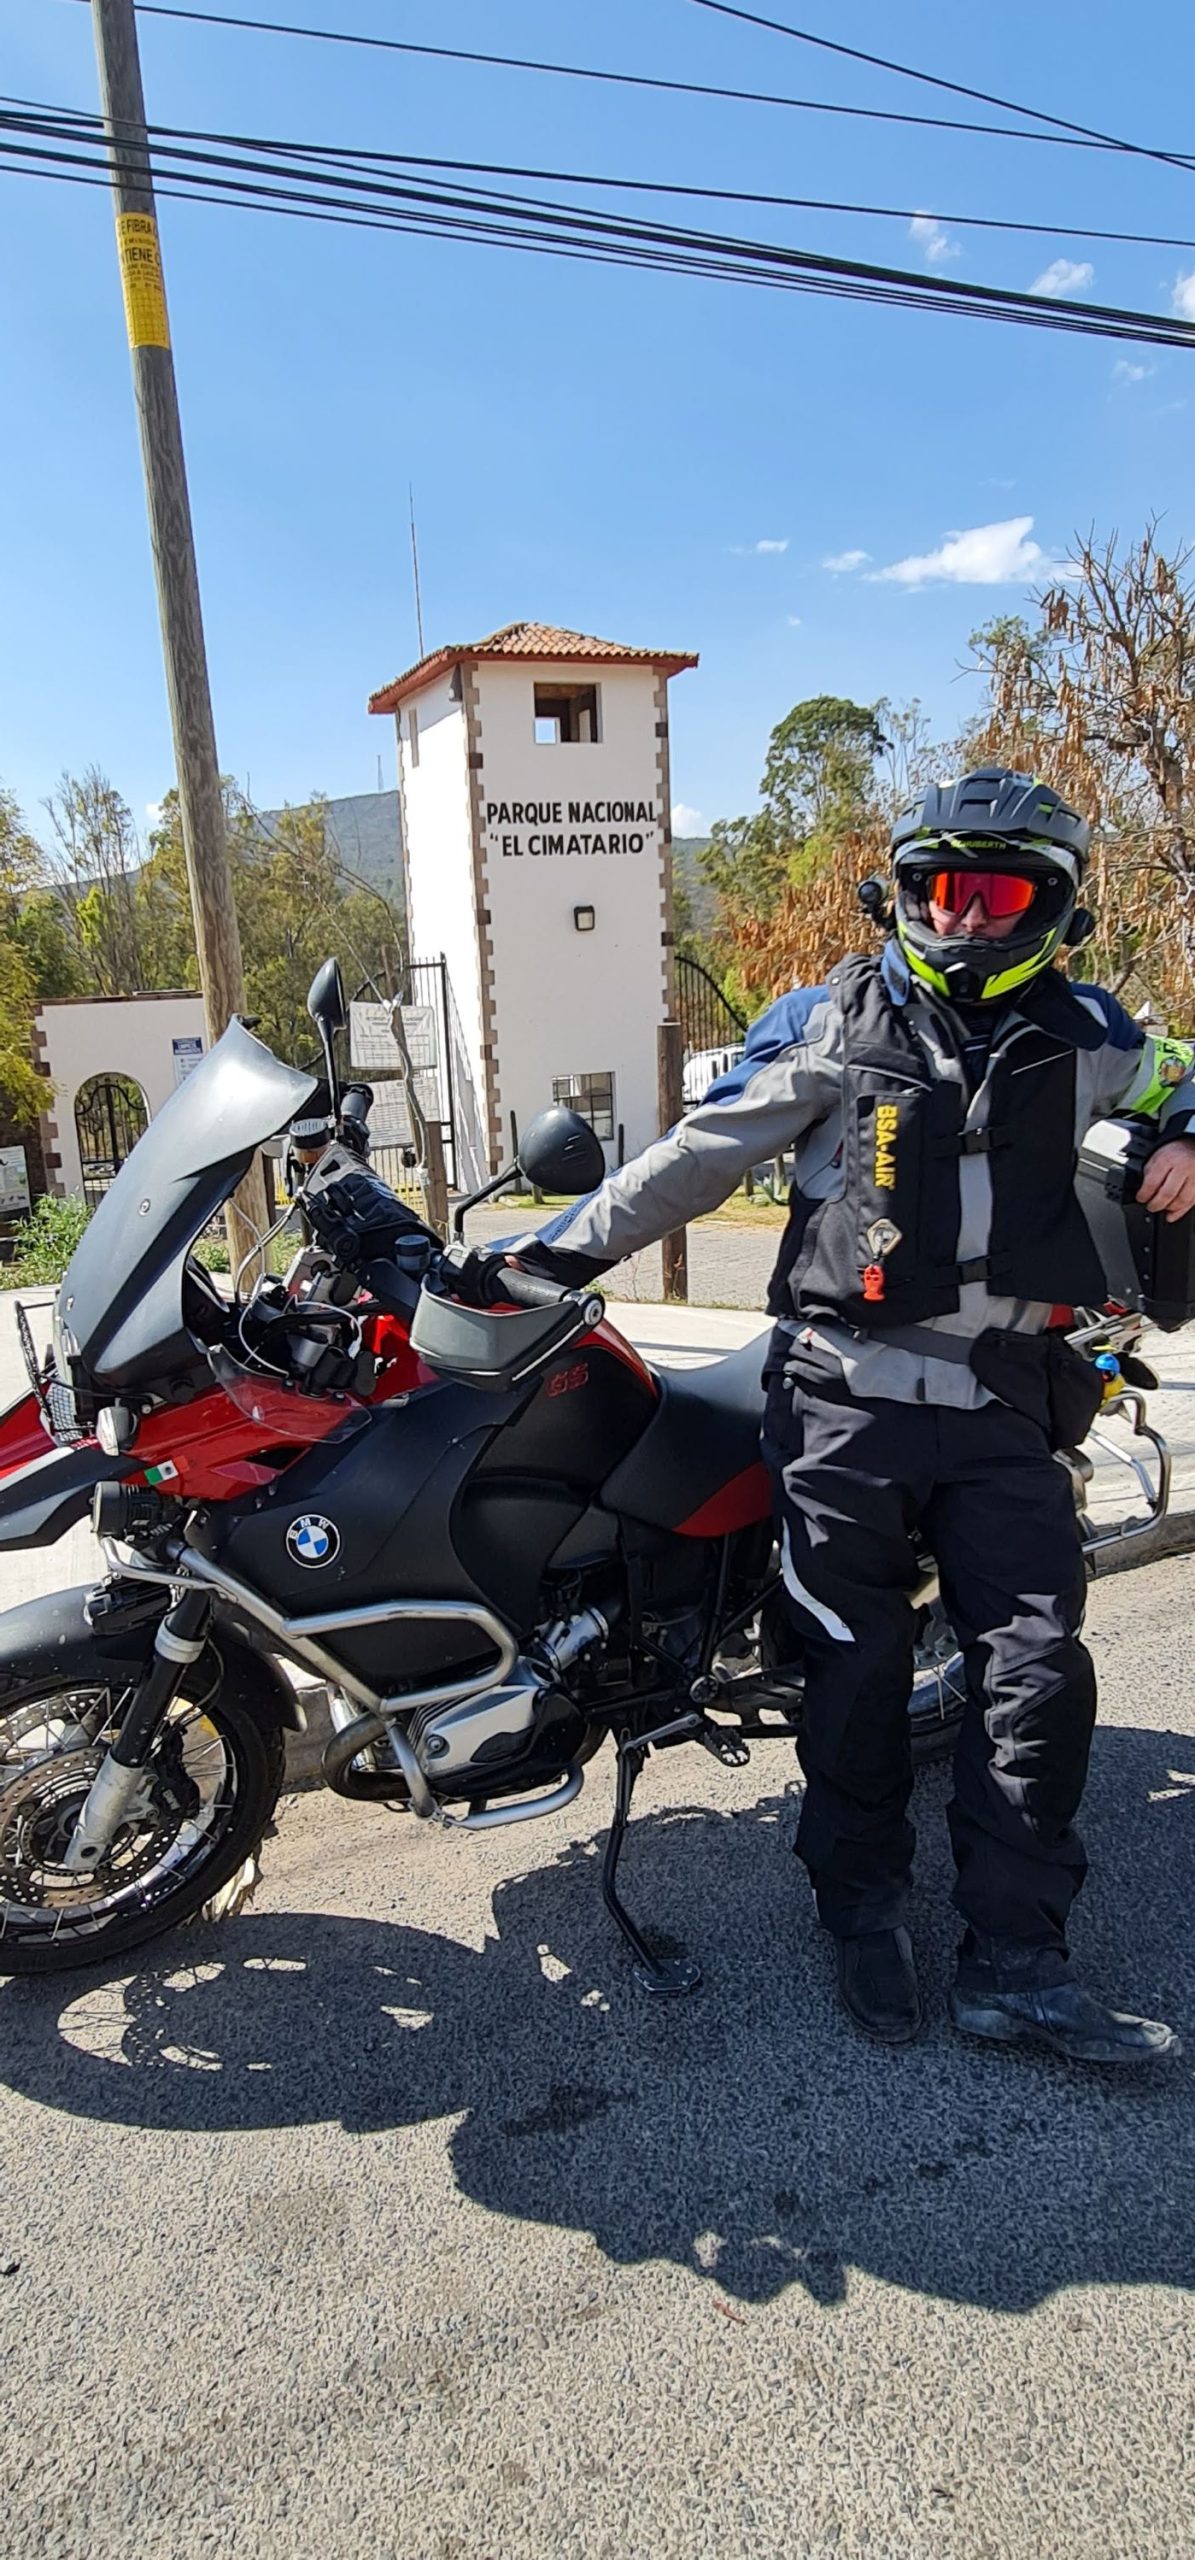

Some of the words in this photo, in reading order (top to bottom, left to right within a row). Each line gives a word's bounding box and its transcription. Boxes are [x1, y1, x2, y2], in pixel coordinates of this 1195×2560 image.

[126, 218, 153, 235] FIBRA
[487, 802, 563, 827] PARQUE
[568, 801, 657, 824] NACIONAL
[489, 832, 524, 857] "EL
[528, 830, 654, 856] CIMATARIO"
[547, 1362, 589, 1398] GS
[288, 1517, 330, 1541] BMW
